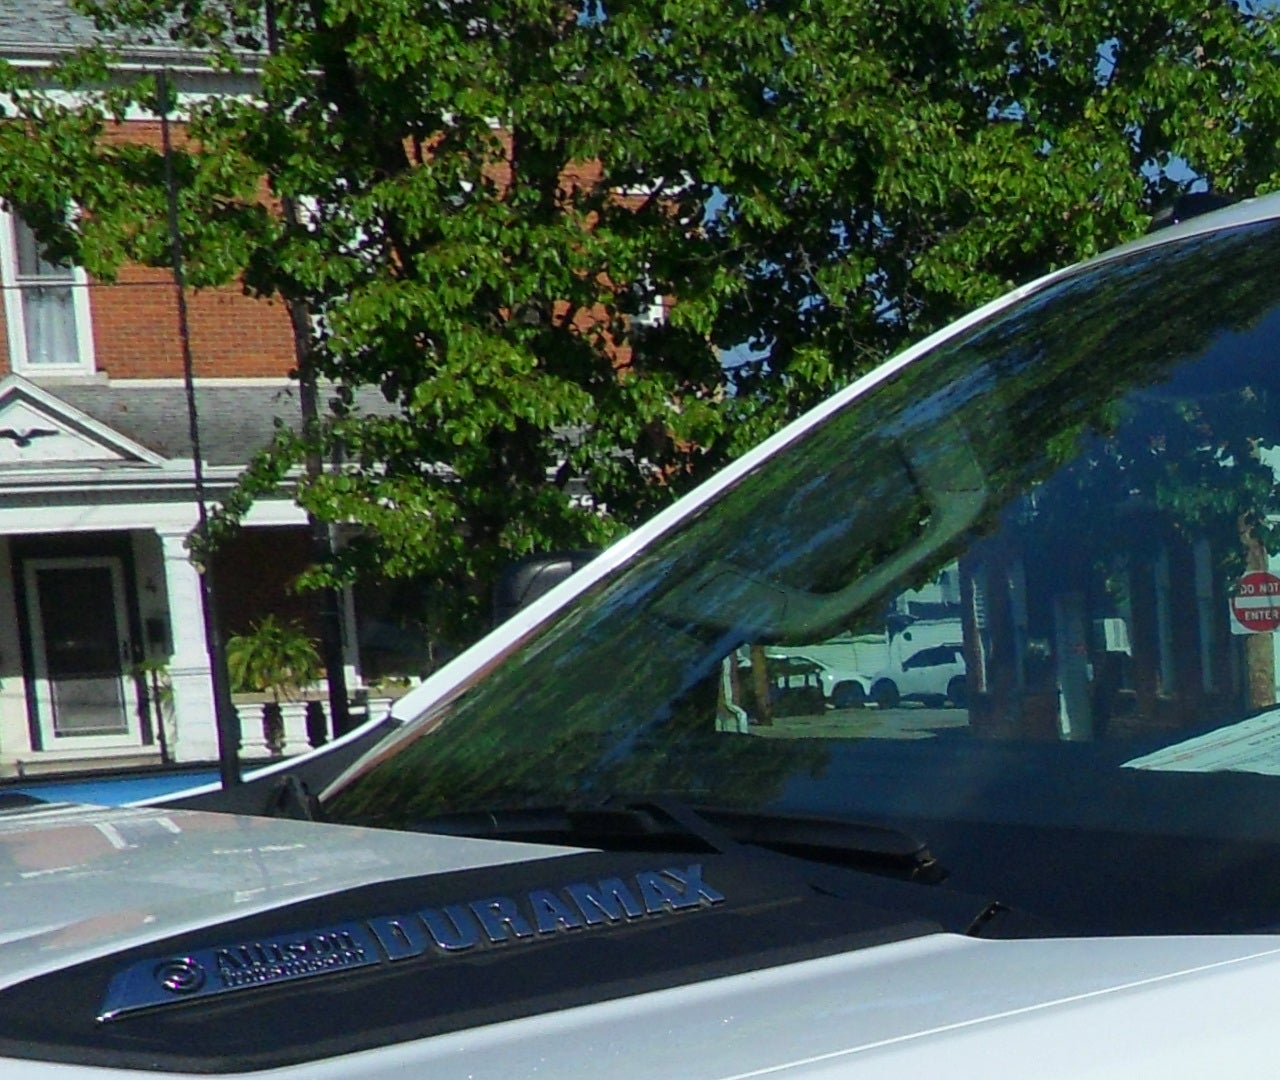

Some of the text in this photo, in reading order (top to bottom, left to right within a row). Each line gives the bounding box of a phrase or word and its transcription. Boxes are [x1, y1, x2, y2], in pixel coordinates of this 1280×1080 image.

[1240, 582, 1279, 594] DO NOT
[1245, 610, 1279, 620] ENTER
[367, 864, 725, 961] DURAMAX
